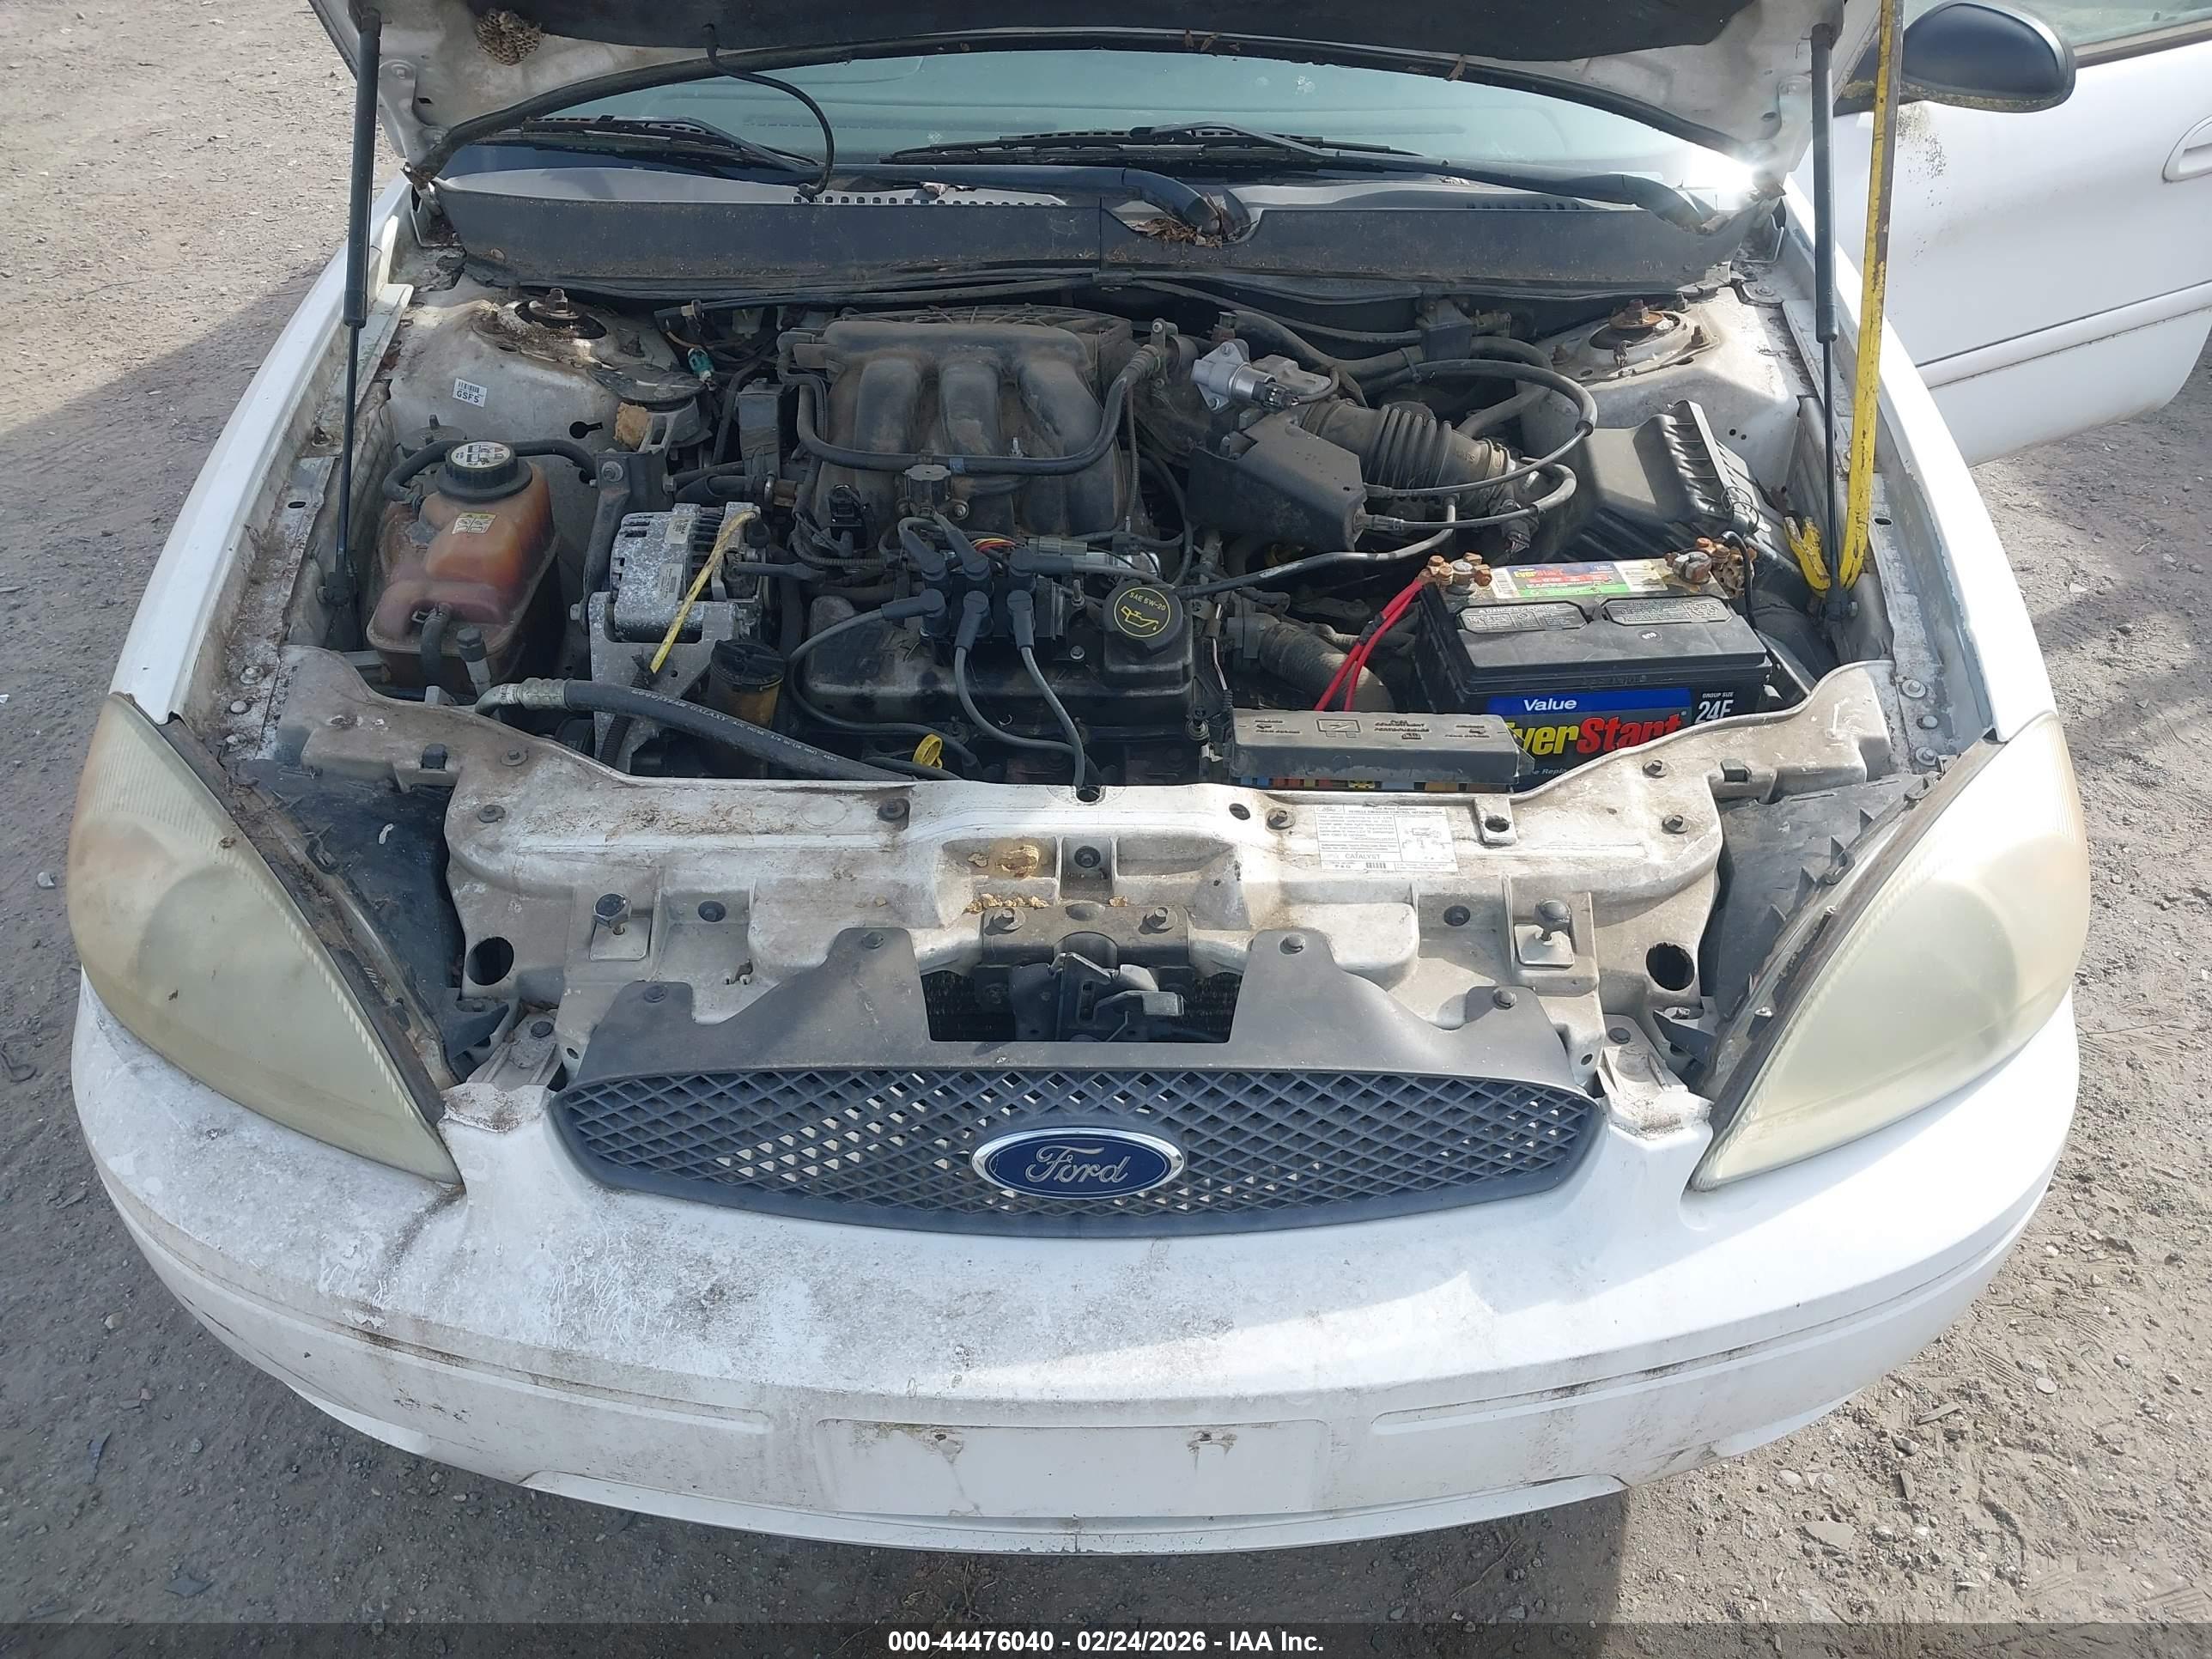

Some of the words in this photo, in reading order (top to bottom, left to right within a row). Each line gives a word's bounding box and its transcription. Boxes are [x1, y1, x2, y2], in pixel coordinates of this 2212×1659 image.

[456, 390, 480, 404] GSF5
[1129, 592, 1144, 602] SAE
[1143, 597, 1167, 611] 5W-20
[1523, 697, 1577, 712] Value
[1505, 714, 1682, 756] verStart
[1024, 1145, 1132, 1183] Ford
